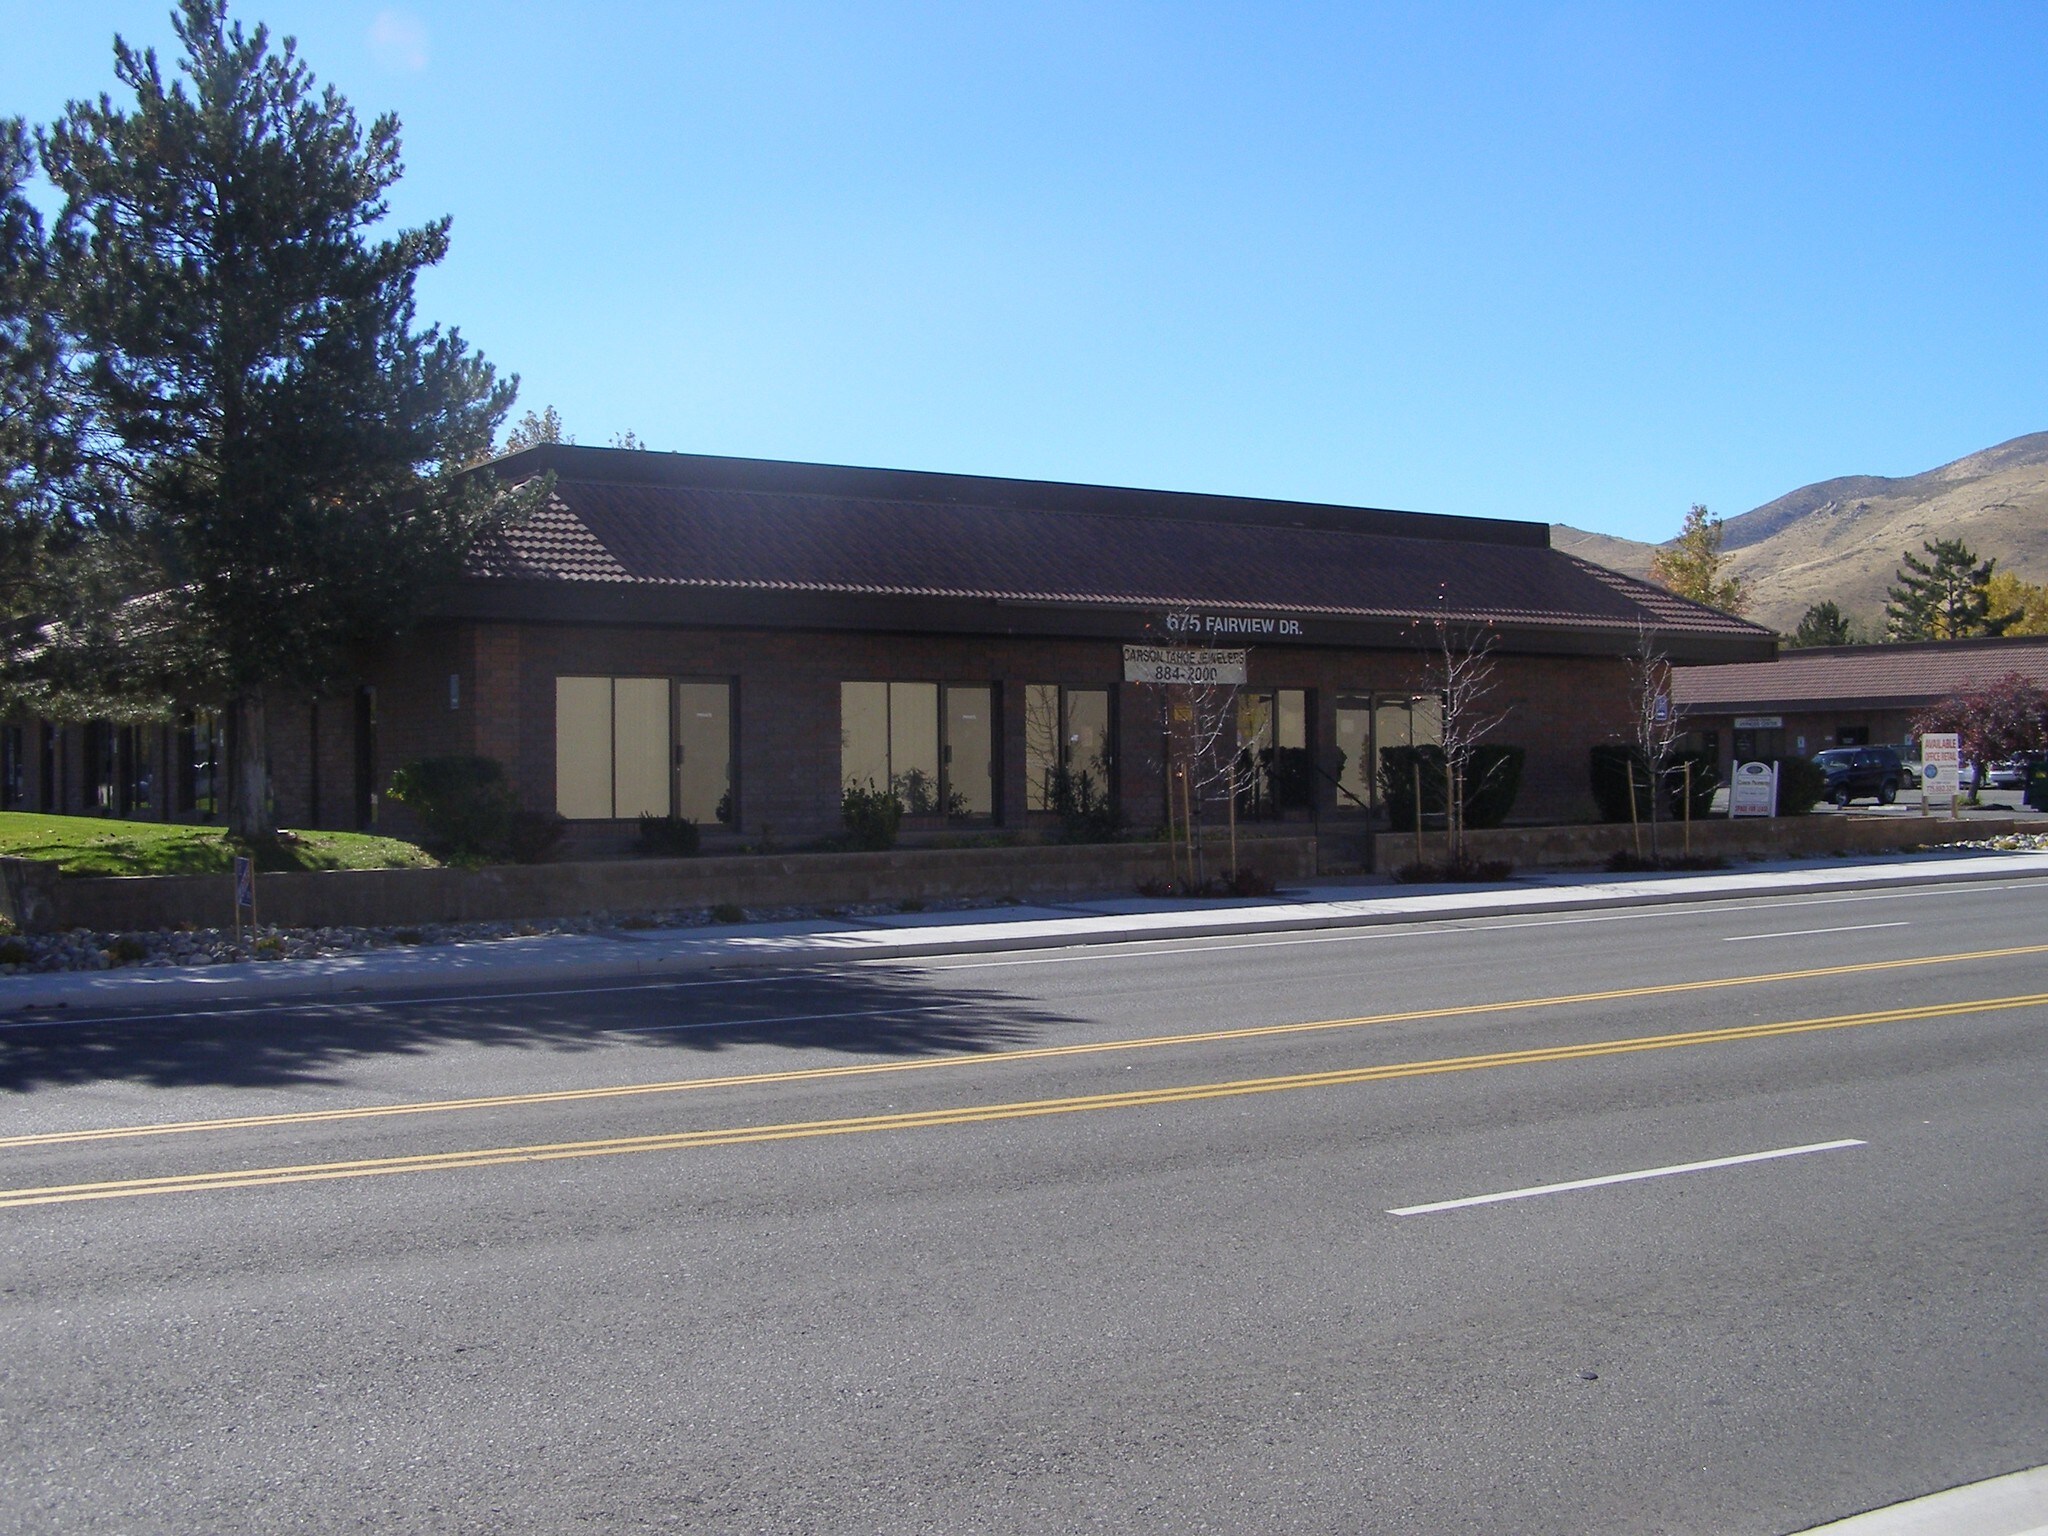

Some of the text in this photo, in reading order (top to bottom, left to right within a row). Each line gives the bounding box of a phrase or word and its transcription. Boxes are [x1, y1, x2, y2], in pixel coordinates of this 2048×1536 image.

[1167, 613, 1303, 635] 675 FAIRVIEW DR.
[1124, 648, 1244, 665] CARSON TAHOE JEWELERS
[1156, 666, 1217, 681] 884-2000
[1925, 738, 1957, 749] AVAILABLE
